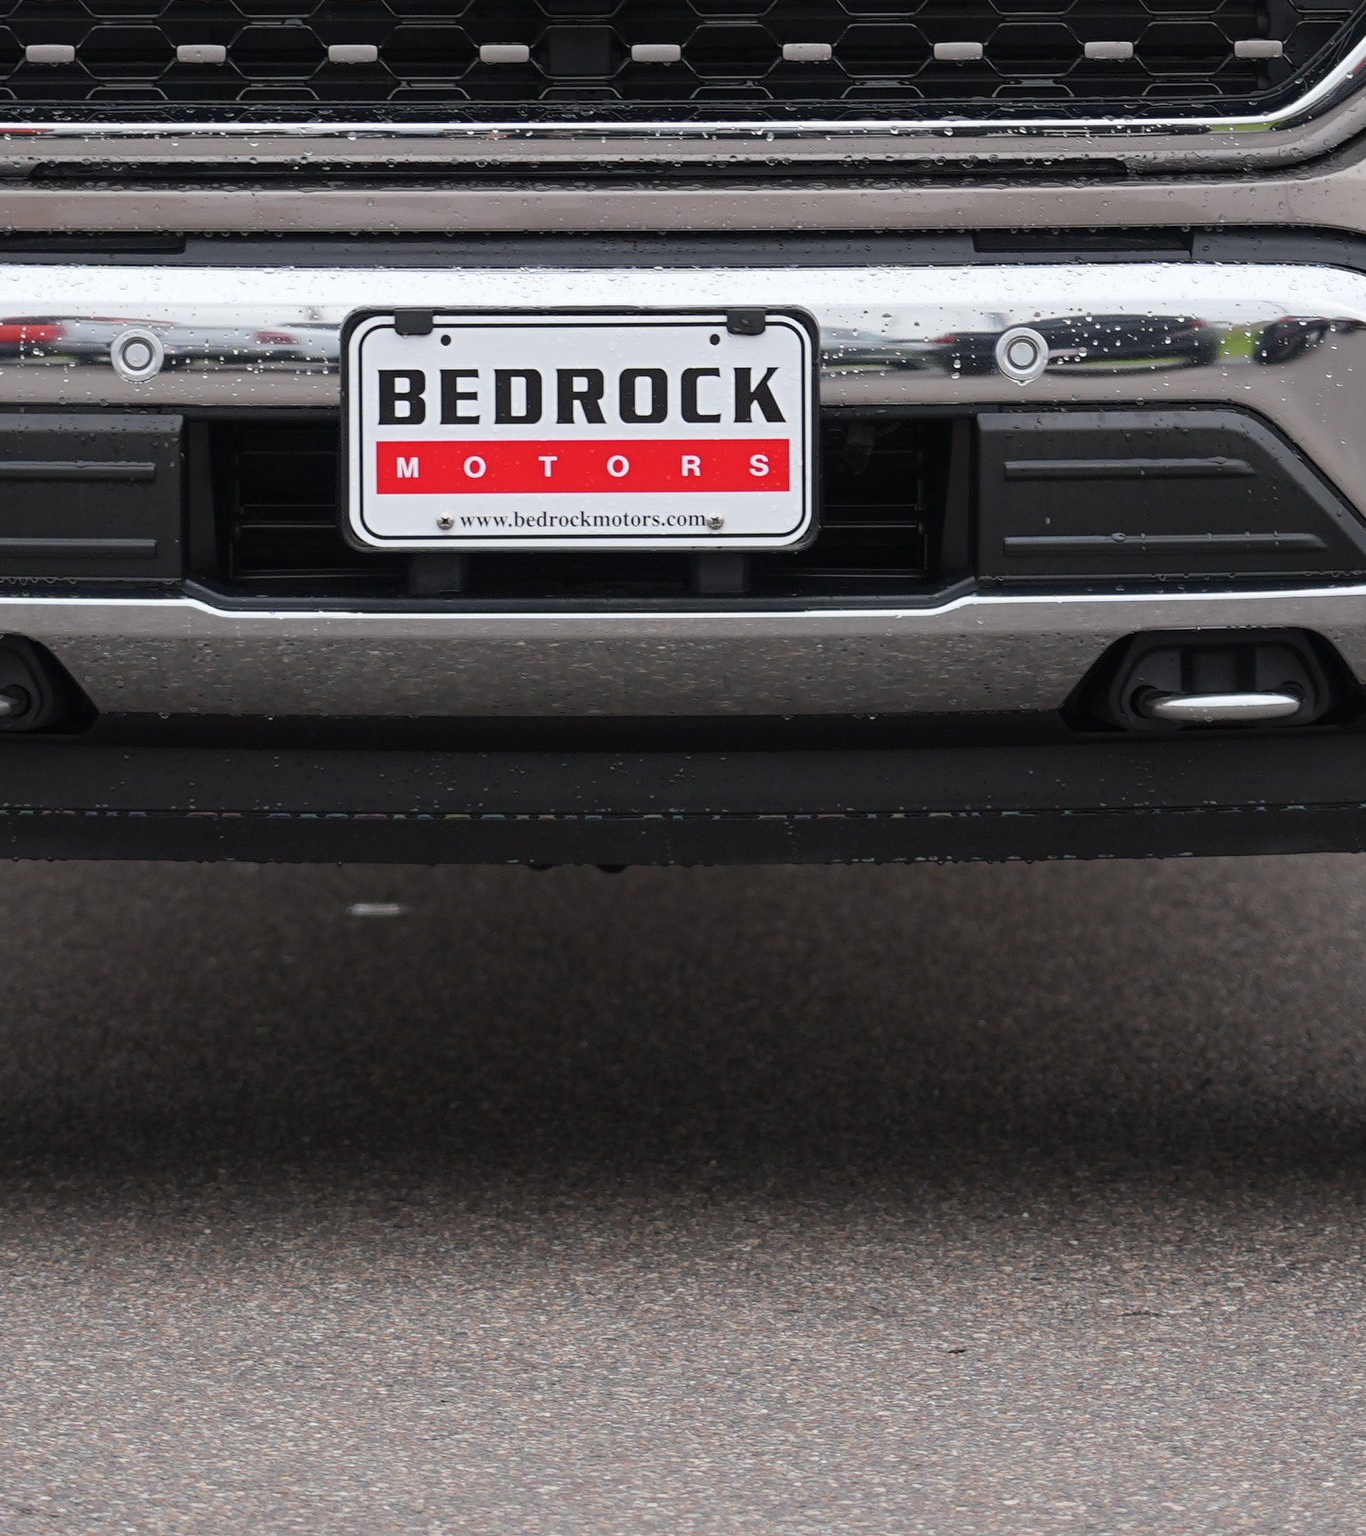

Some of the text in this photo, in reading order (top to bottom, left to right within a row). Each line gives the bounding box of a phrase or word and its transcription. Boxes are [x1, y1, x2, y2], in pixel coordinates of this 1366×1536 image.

[377, 366, 787, 426] BEDROCK
[395, 453, 770, 479] MOTORS
[460, 510, 707, 529] www.bedrockmotors.com
